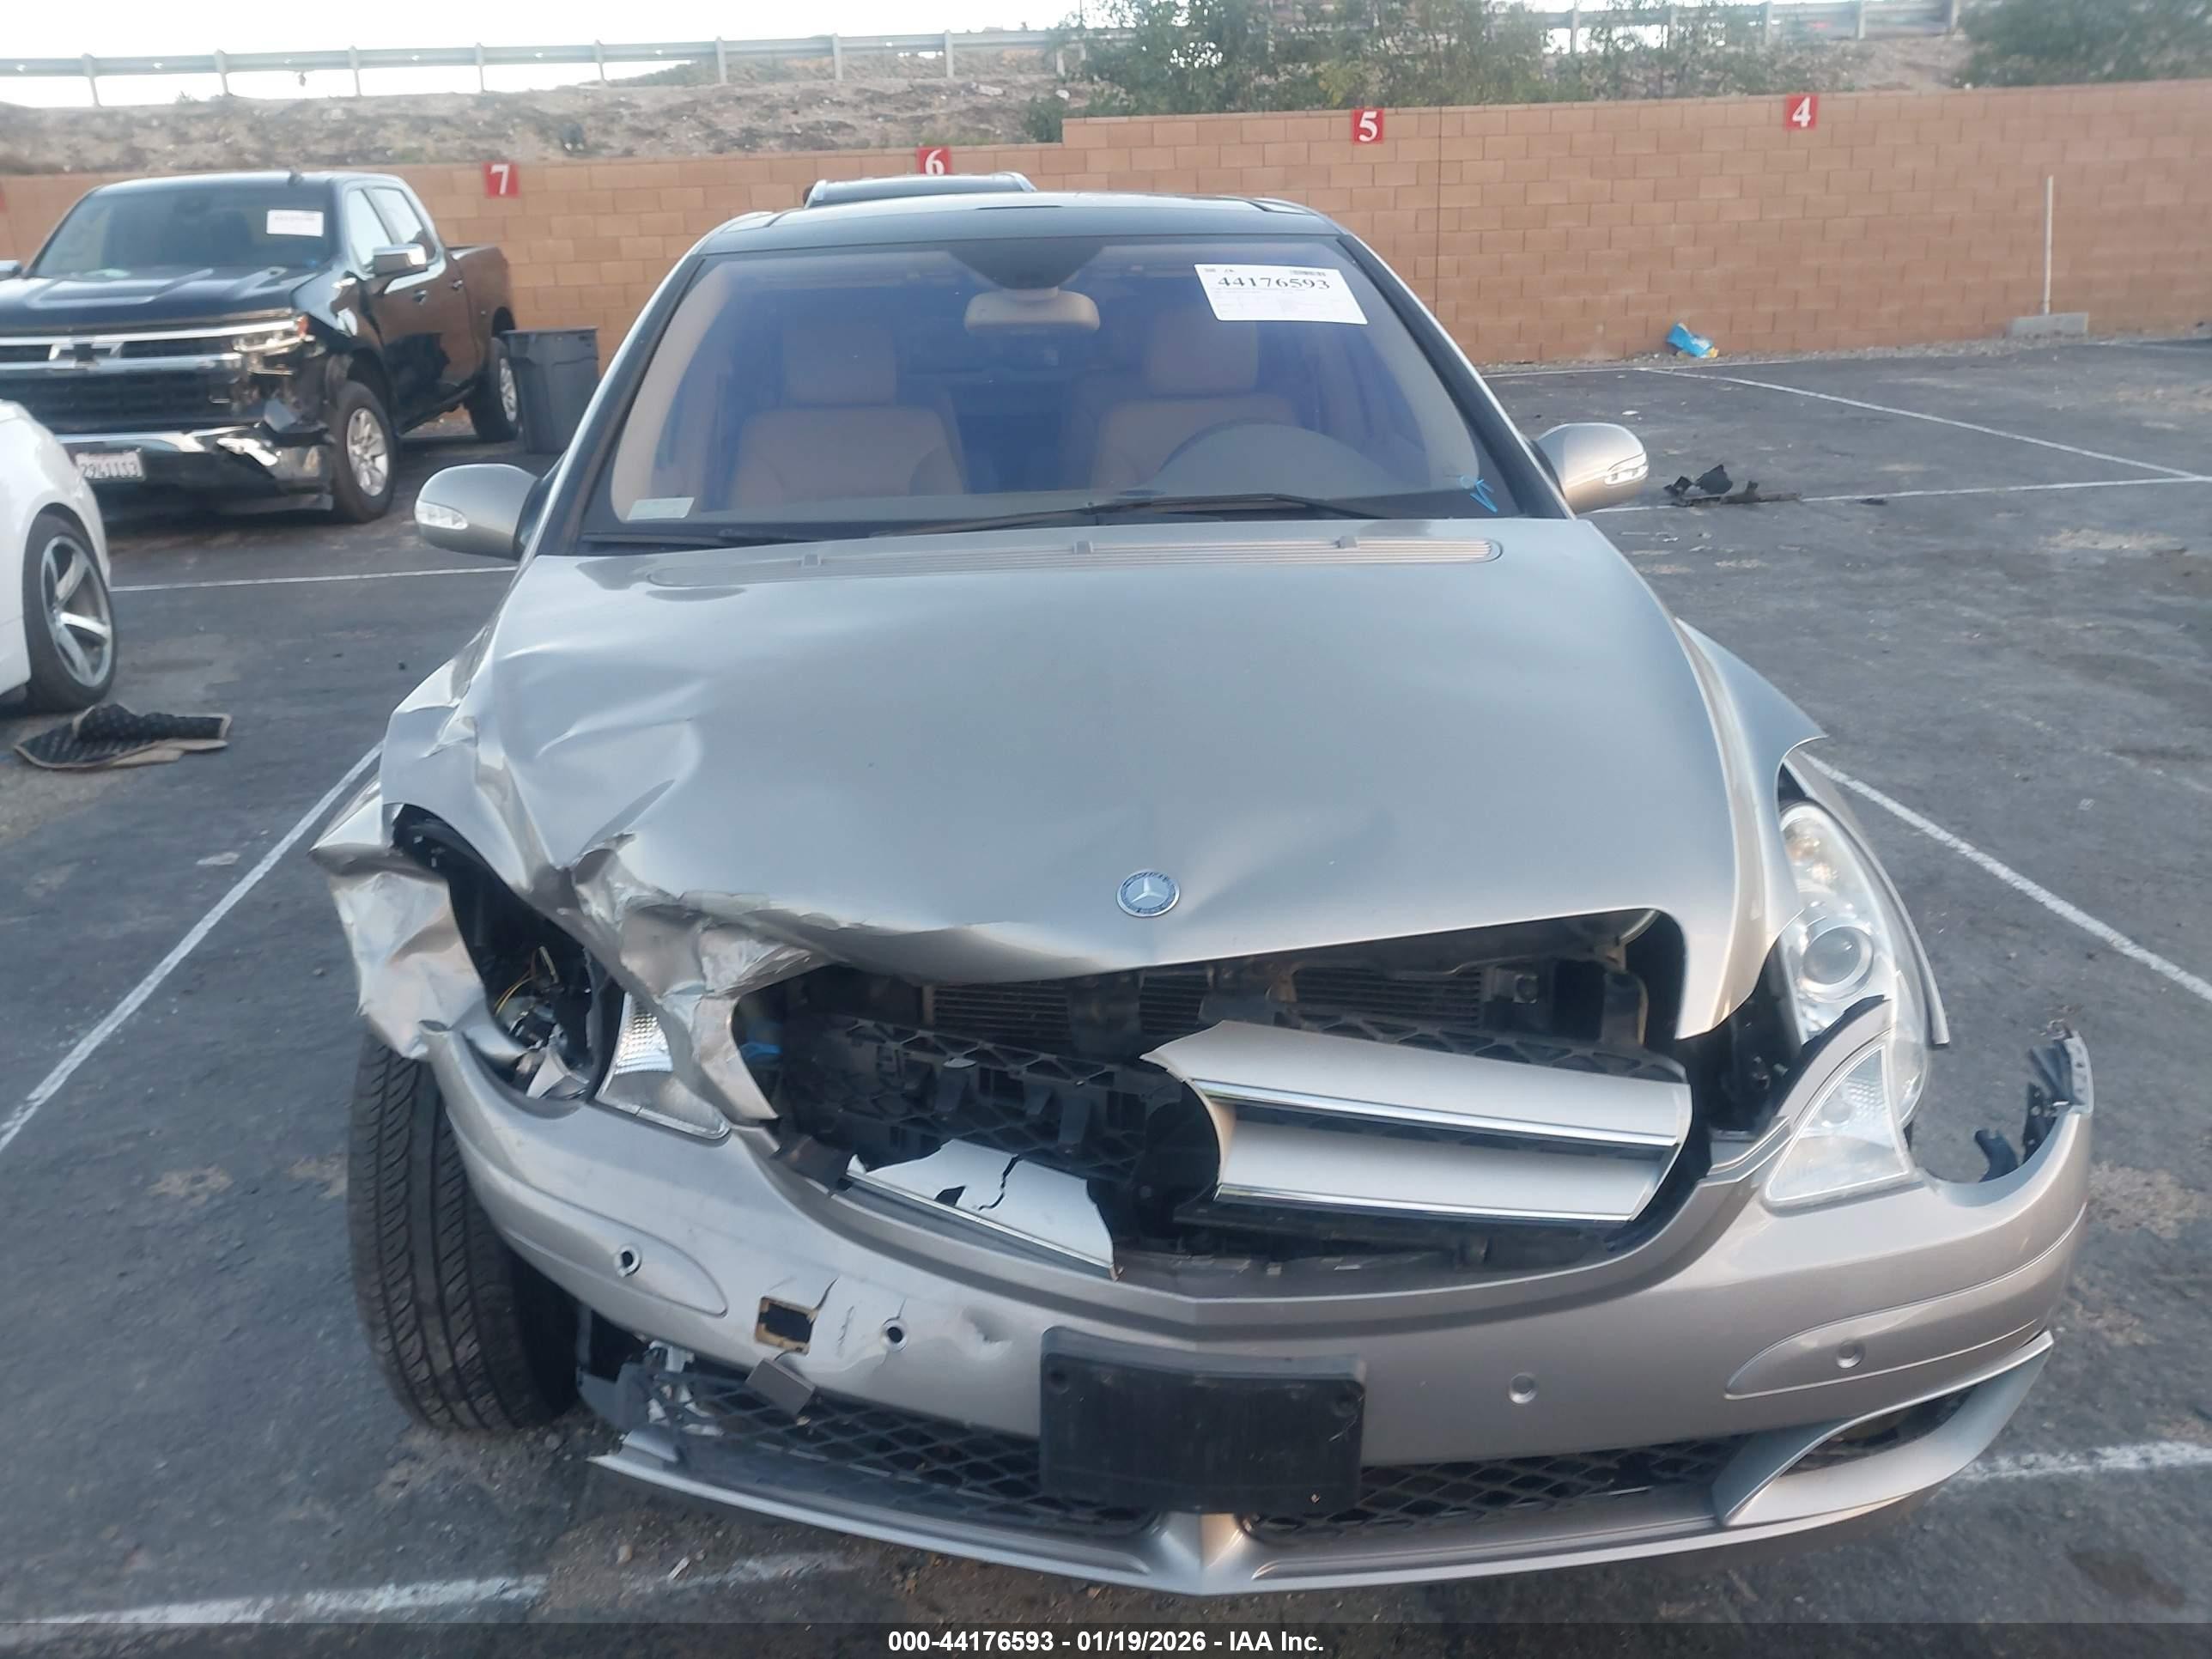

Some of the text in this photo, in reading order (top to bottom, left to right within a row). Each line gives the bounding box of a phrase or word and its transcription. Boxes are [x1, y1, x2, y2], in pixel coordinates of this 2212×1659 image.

[1358, 111, 1378, 142] 5
[1792, 96, 1811, 127] 4
[925, 149, 945, 175] 6
[490, 164, 509, 195] 7
[1218, 276, 1331, 290] 44176593
